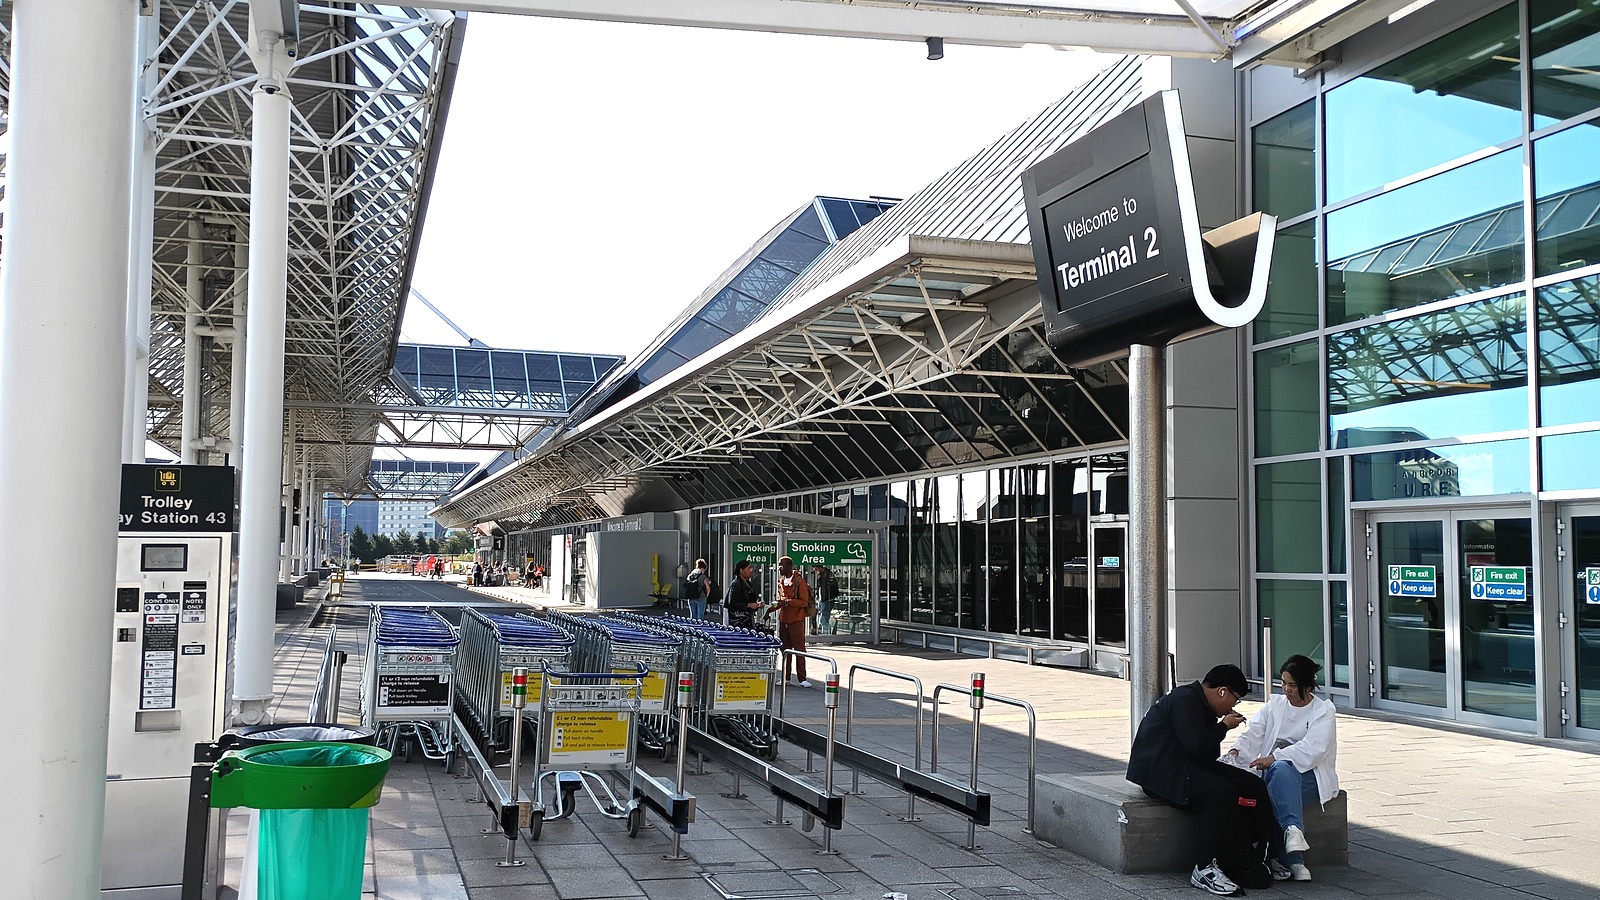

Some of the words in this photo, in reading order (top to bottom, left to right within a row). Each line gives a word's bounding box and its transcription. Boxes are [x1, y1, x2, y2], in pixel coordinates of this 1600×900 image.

[1063, 206, 1118, 242] Welcome
[1122, 198, 1137, 216] to
[1058, 235, 1138, 290] Terminal
[1144, 226, 1160, 258] 2
[141, 496, 192, 510] Trolley
[118, 514, 134, 525] ay
[141, 512, 198, 524] Station
[206, 512, 226, 524] 43
[736, 544, 776, 554] Smoking
[792, 542, 836, 554] Smoking
[802, 555, 825, 563] Area
[1402, 583, 1418, 592] Keep
[1487, 587, 1505, 596] Keep
